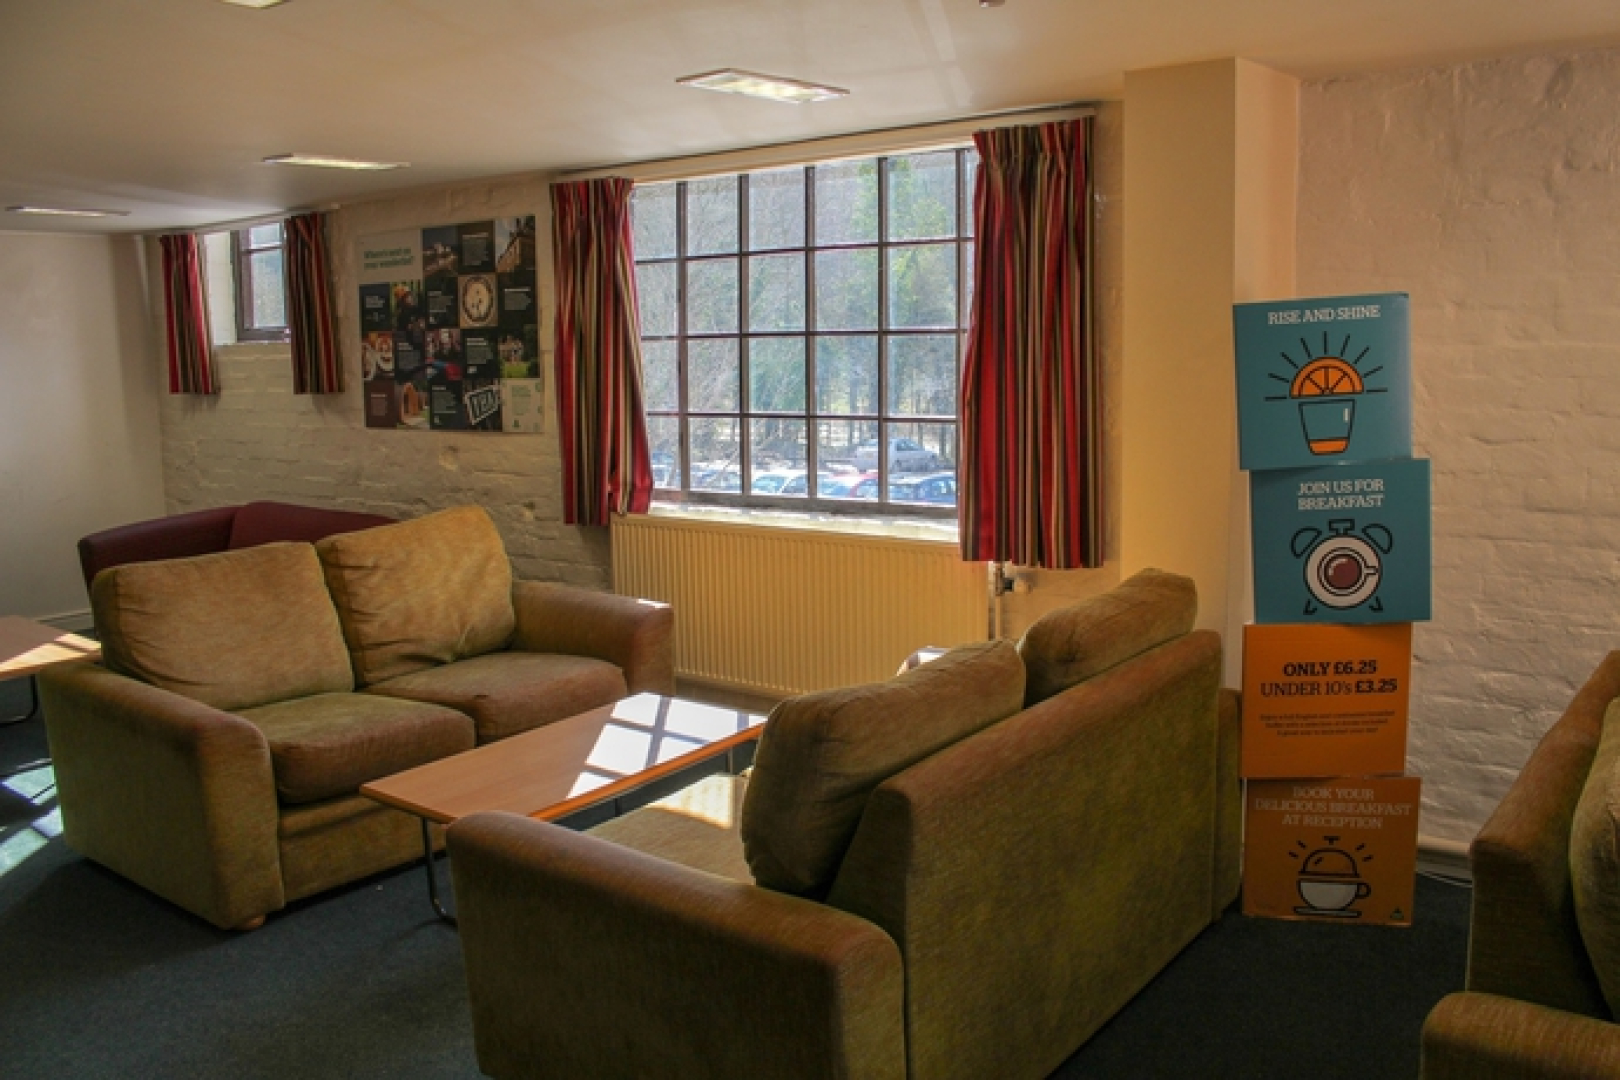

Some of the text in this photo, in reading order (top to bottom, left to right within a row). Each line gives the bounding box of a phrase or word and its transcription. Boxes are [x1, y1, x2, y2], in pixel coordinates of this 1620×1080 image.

[1268, 304, 1381, 325] RISE AND SHINE
[1298, 478, 1384, 496] JOIN US FOR
[1298, 493, 1385, 511] BREAKFAST
[1283, 659, 1377, 677] ONLY £6.25
[1260, 680, 1321, 698] UNDER
[1355, 677, 1398, 694] £3.25
[1293, 786, 1374, 801] BOOK YOUR
[1255, 798, 1412, 816] DELICIOUS BREAKFAST
[1282, 814, 1384, 830] AT RECEPTION
